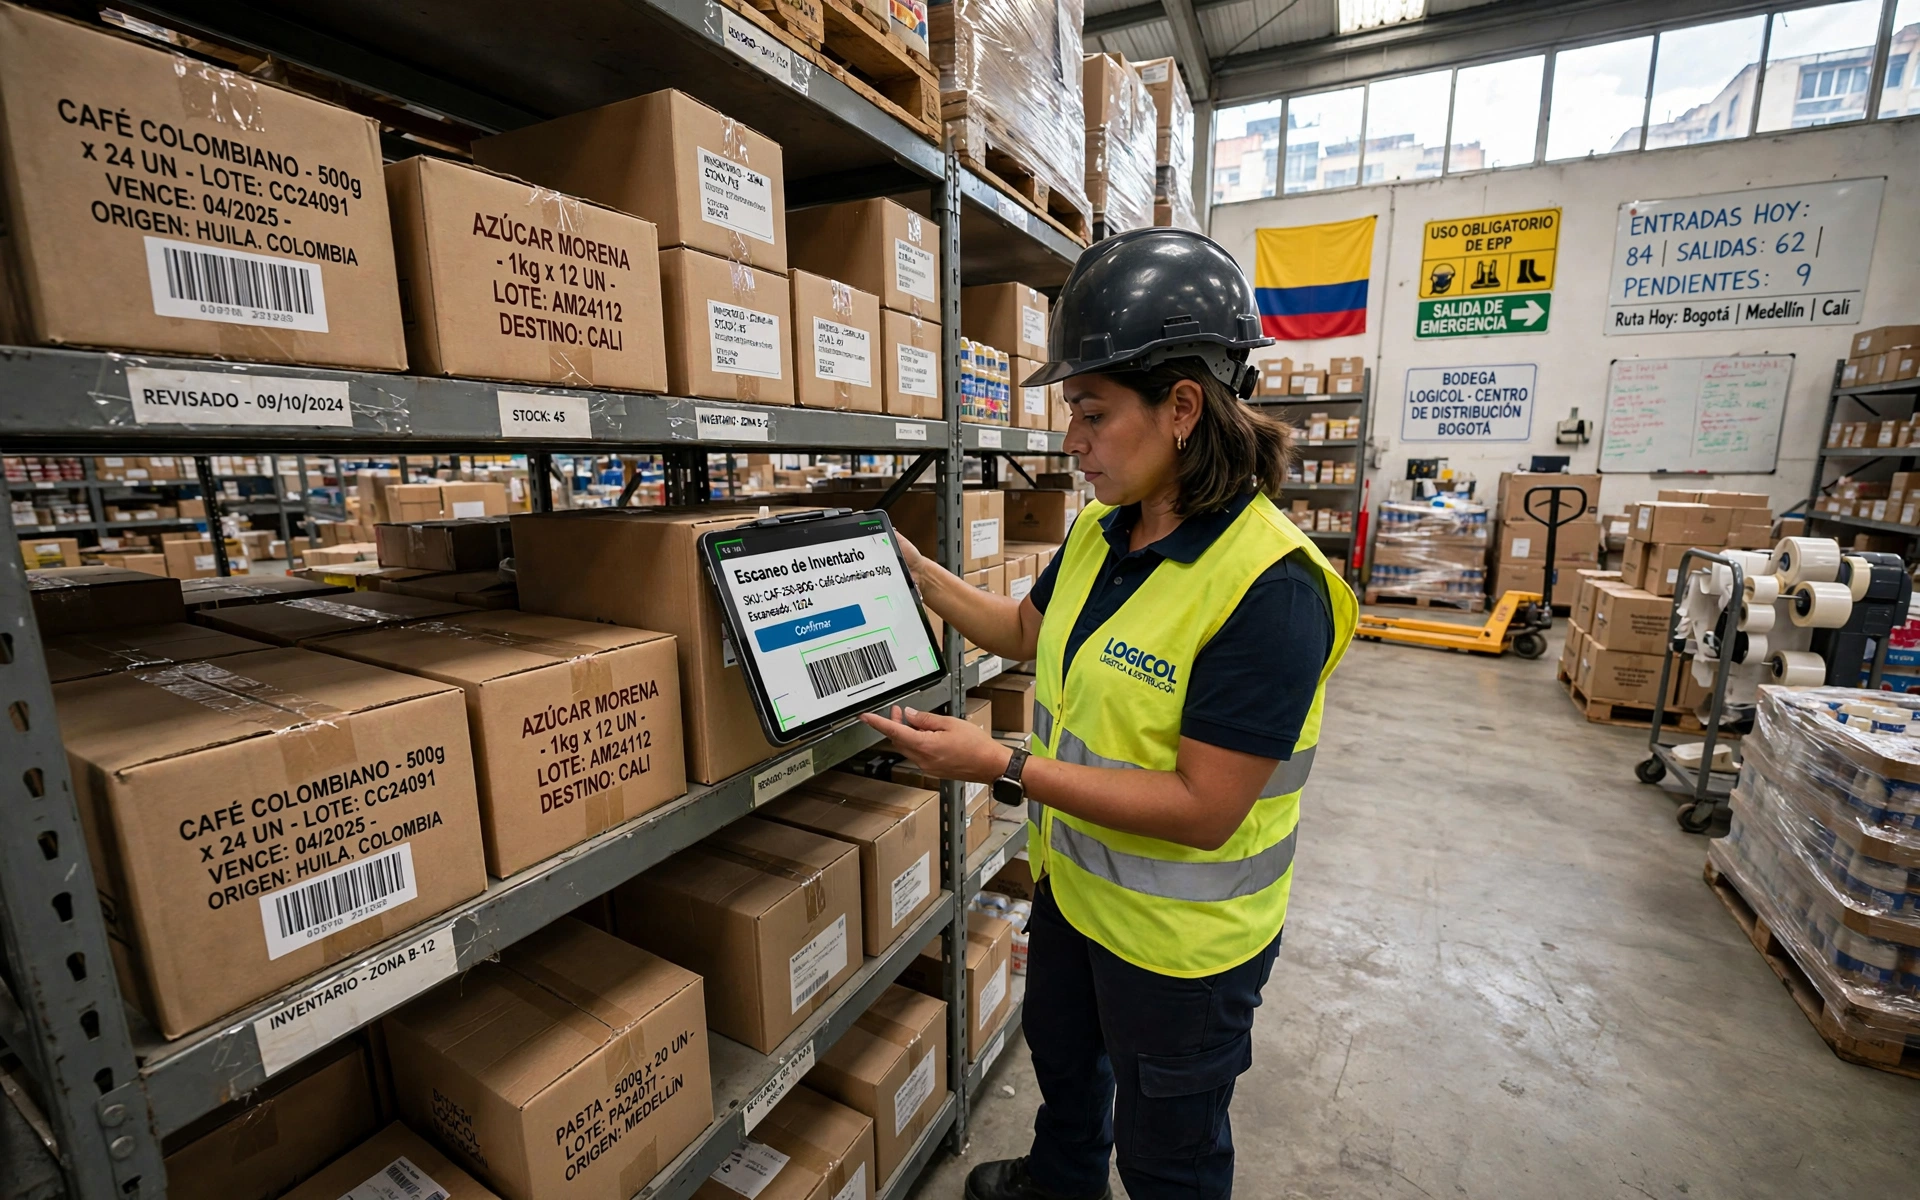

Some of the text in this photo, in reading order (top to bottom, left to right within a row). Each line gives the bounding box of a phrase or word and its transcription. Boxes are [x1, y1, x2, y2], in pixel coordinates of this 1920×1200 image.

[58, 99, 134, 139] CAFÉ
[141, 119, 298, 178] COLOMBIANO
[318, 165, 362, 199] 500g
[81, 141, 97, 161] x
[105, 143, 135, 169] 24
[142, 150, 178, 178] UN
[200, 164, 262, 197] LOTE:
[269, 181, 348, 216] CC24091
[105, 173, 196, 210] VENCE:
[203, 194, 278, 226] 04/2025
[91, 200, 190, 237] ORIGEN:
[267, 233, 358, 267] COLOMBIA
[1431, 215, 1554, 239] USO OBLIGATORIO
[1630, 200, 1811, 236] ENTRADAS HOY:
[473, 212, 630, 271] AZÚCAR MORENA
[1465, 236, 1513, 252] DE EPP
[1626, 244, 1653, 267] 84
[1677, 236, 1765, 262] SALIDAS:
[1775, 231, 1806, 254] 62
[509, 252, 540, 284] 1kg
[545, 264, 554, 282] x
[560, 263, 578, 286] 12
[583, 267, 606, 292] UN
[1624, 263, 1812, 298] PENDIENTES: 9
[493, 280, 623, 322] LOTE: AM24112
[1433, 299, 1504, 319] SALIDA DE
[1615, 311, 1645, 327] Ruta
[1648, 309, 1678, 329] Hoy:
[1683, 305, 1730, 326] Bogotá
[1746, 300, 1804, 321] Medellín
[1822, 298, 1850, 317] Cali
[500, 312, 623, 351] DESTINO: CALI
[1420, 315, 1507, 334] EMERGENCIA
[1410, 389, 1464, 403] LOGICOL
[1475, 387, 1528, 402] CENTRO
[1442, 371, 1497, 386] BODEGA
[143, 388, 239, 409] REVISADO
[256, 394, 345, 413] 09/10/2024
[512, 409, 566, 423] STOCK: 45
[1411, 402, 1522, 420] DE DISTRIBUCIÓN
[1438, 420, 1491, 435] BOGOTÁ
[734, 548, 865, 585] Escaneo de Inventario
[795, 619, 831, 637] Confirmar
[1104, 637, 1177, 684] LOGICOL
[522, 680, 659, 739] AZÚCAR MORENA
[551, 733, 579, 754] 1kg
[584, 729, 592, 745] x
[596, 718, 613, 739] 12
[616, 710, 637, 732] UN
[537, 730, 651, 788] LOTE: AM24112
[179, 800, 245, 841] CAFÉ
[251, 760, 389, 818] COLOMBIANO
[406, 746, 445, 770] 500g
[540, 754, 650, 814] DESTINO: CALI
[200, 844, 213, 863] x
[220, 831, 247, 856] 24
[252, 818, 284, 845] UN
[303, 795, 360, 828] LOTE:
[365, 769, 436, 809] CC24091
[208, 845, 289, 885] VENCE:
[295, 816, 365, 854] 04/2025
[208, 810, 443, 911] ORIGEN: HUILA, COLOMBIA
[270, 977, 358, 1030] INVENTARIO
[368, 954, 406, 981] ZONA
[408, 939, 436, 961] B-12
[556, 1098, 603, 1146] PASTA
[615, 1069, 642, 1099] 500g
[645, 1062, 652, 1076] x
[655, 1047, 668, 1067] 20
[672, 1030, 688, 1054] UN
[565, 1127, 622, 1181] ORIGEN:
[625, 1073, 684, 1133] MEDELLÍN
[566, 1119, 606, 1161] LOTE:
